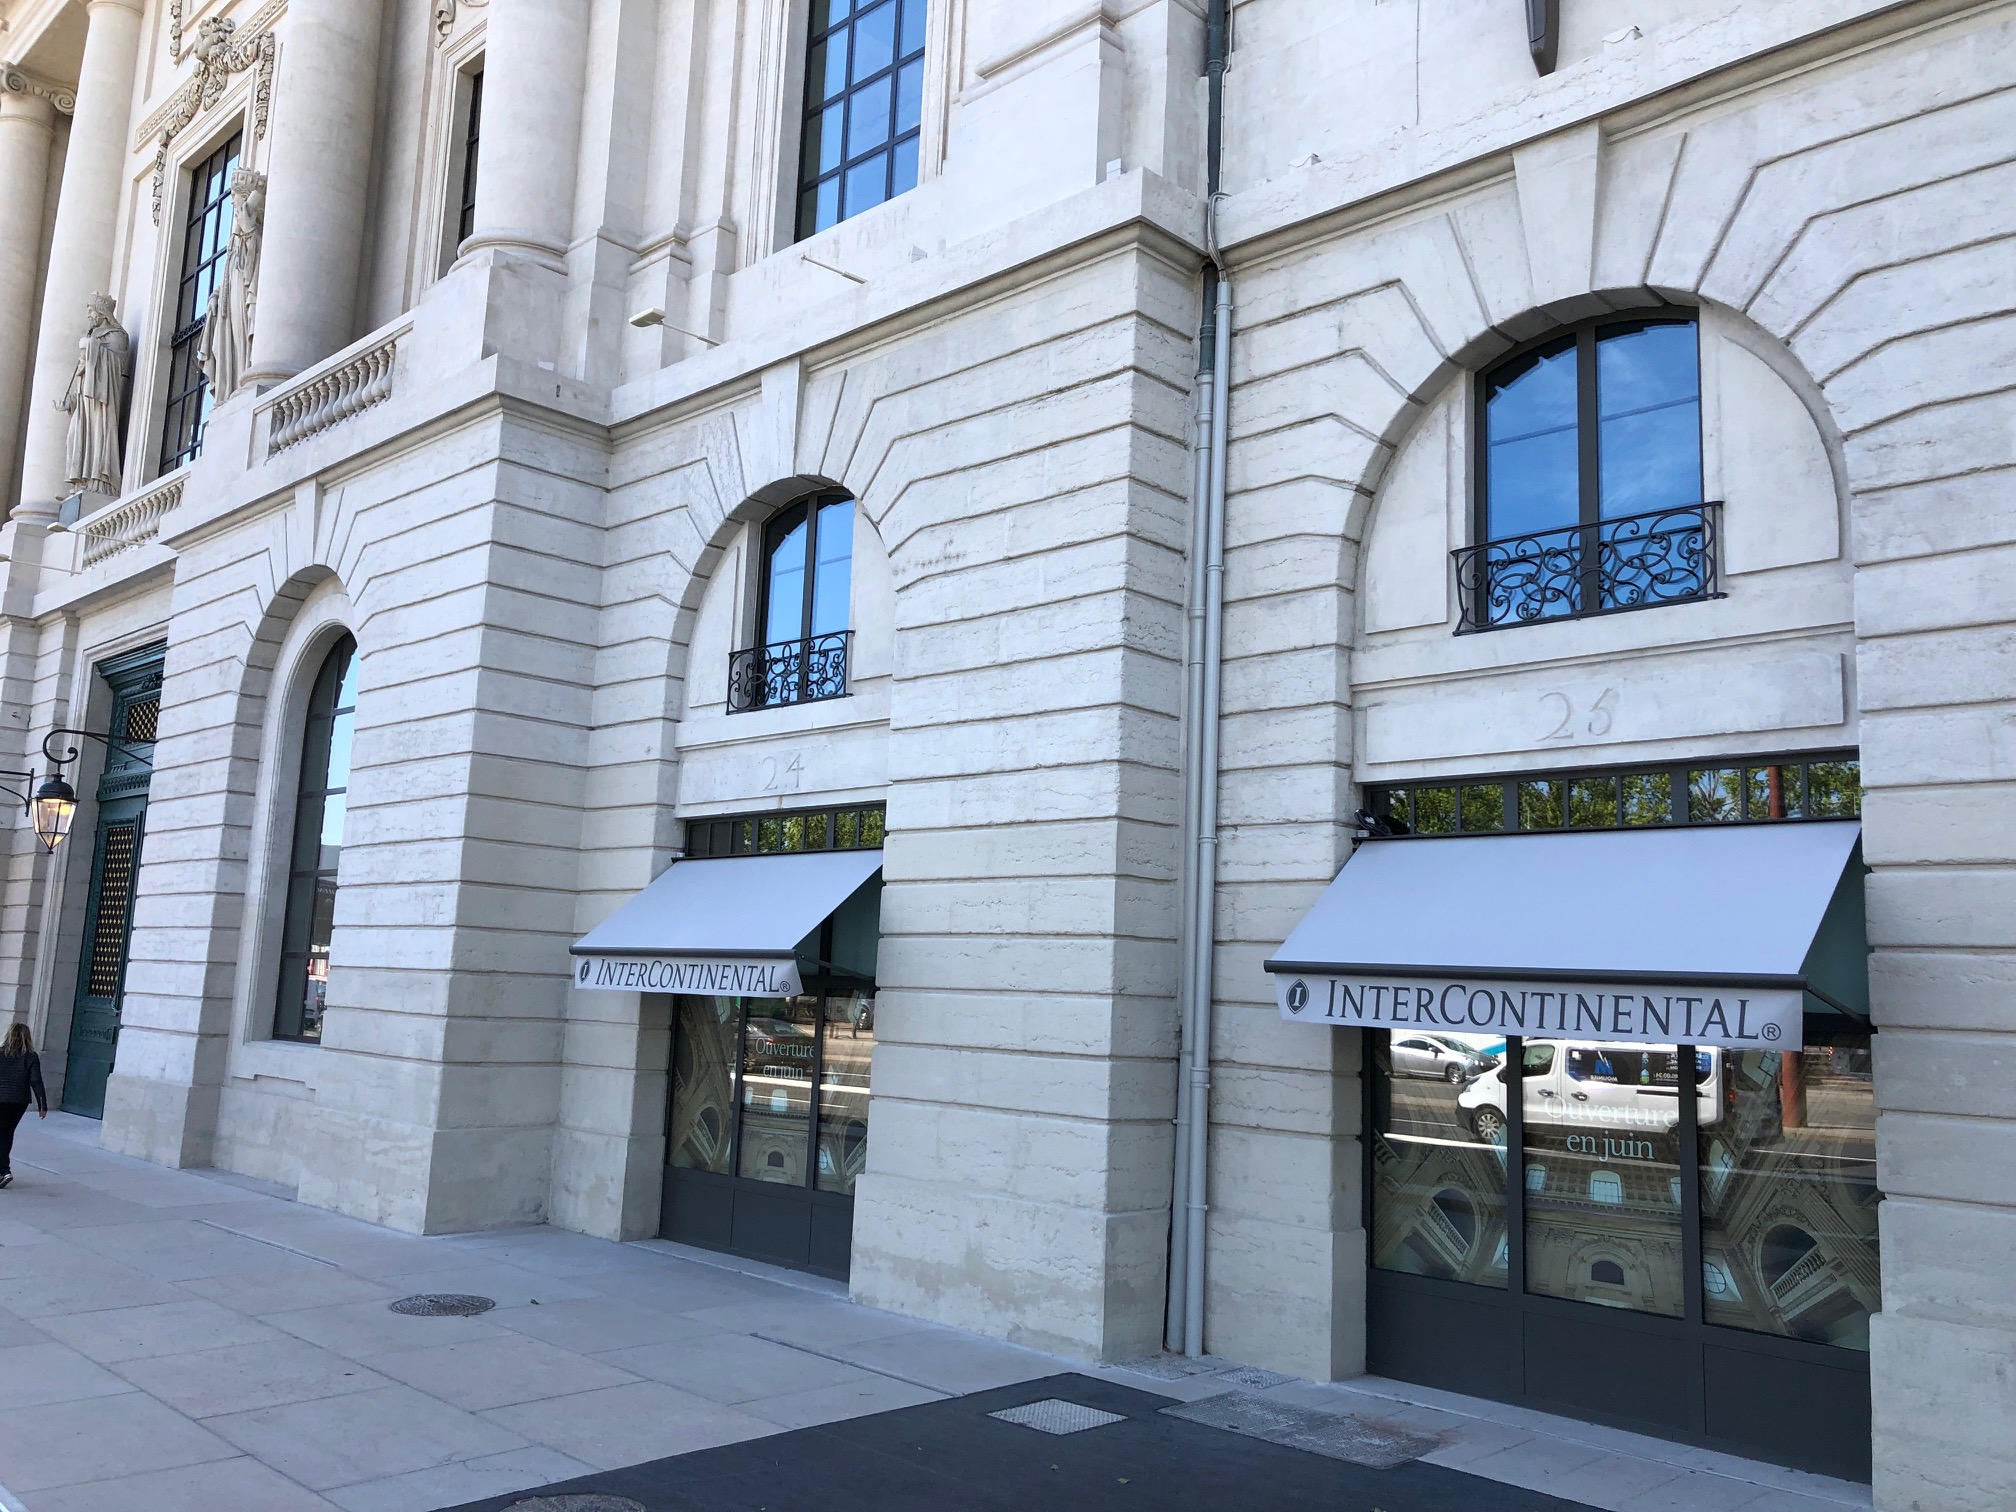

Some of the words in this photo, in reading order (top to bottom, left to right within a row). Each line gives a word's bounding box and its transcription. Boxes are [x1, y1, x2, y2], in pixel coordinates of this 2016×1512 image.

[761, 752, 805, 792] 24
[756, 1037, 815, 1058] Ouverture
[763, 1065, 778, 1078] en
[780, 1061, 804, 1079] juin
[1544, 1096, 1678, 1127] Ouverture
[1566, 1134, 1597, 1154] en
[1598, 1130, 1655, 1162] juin
